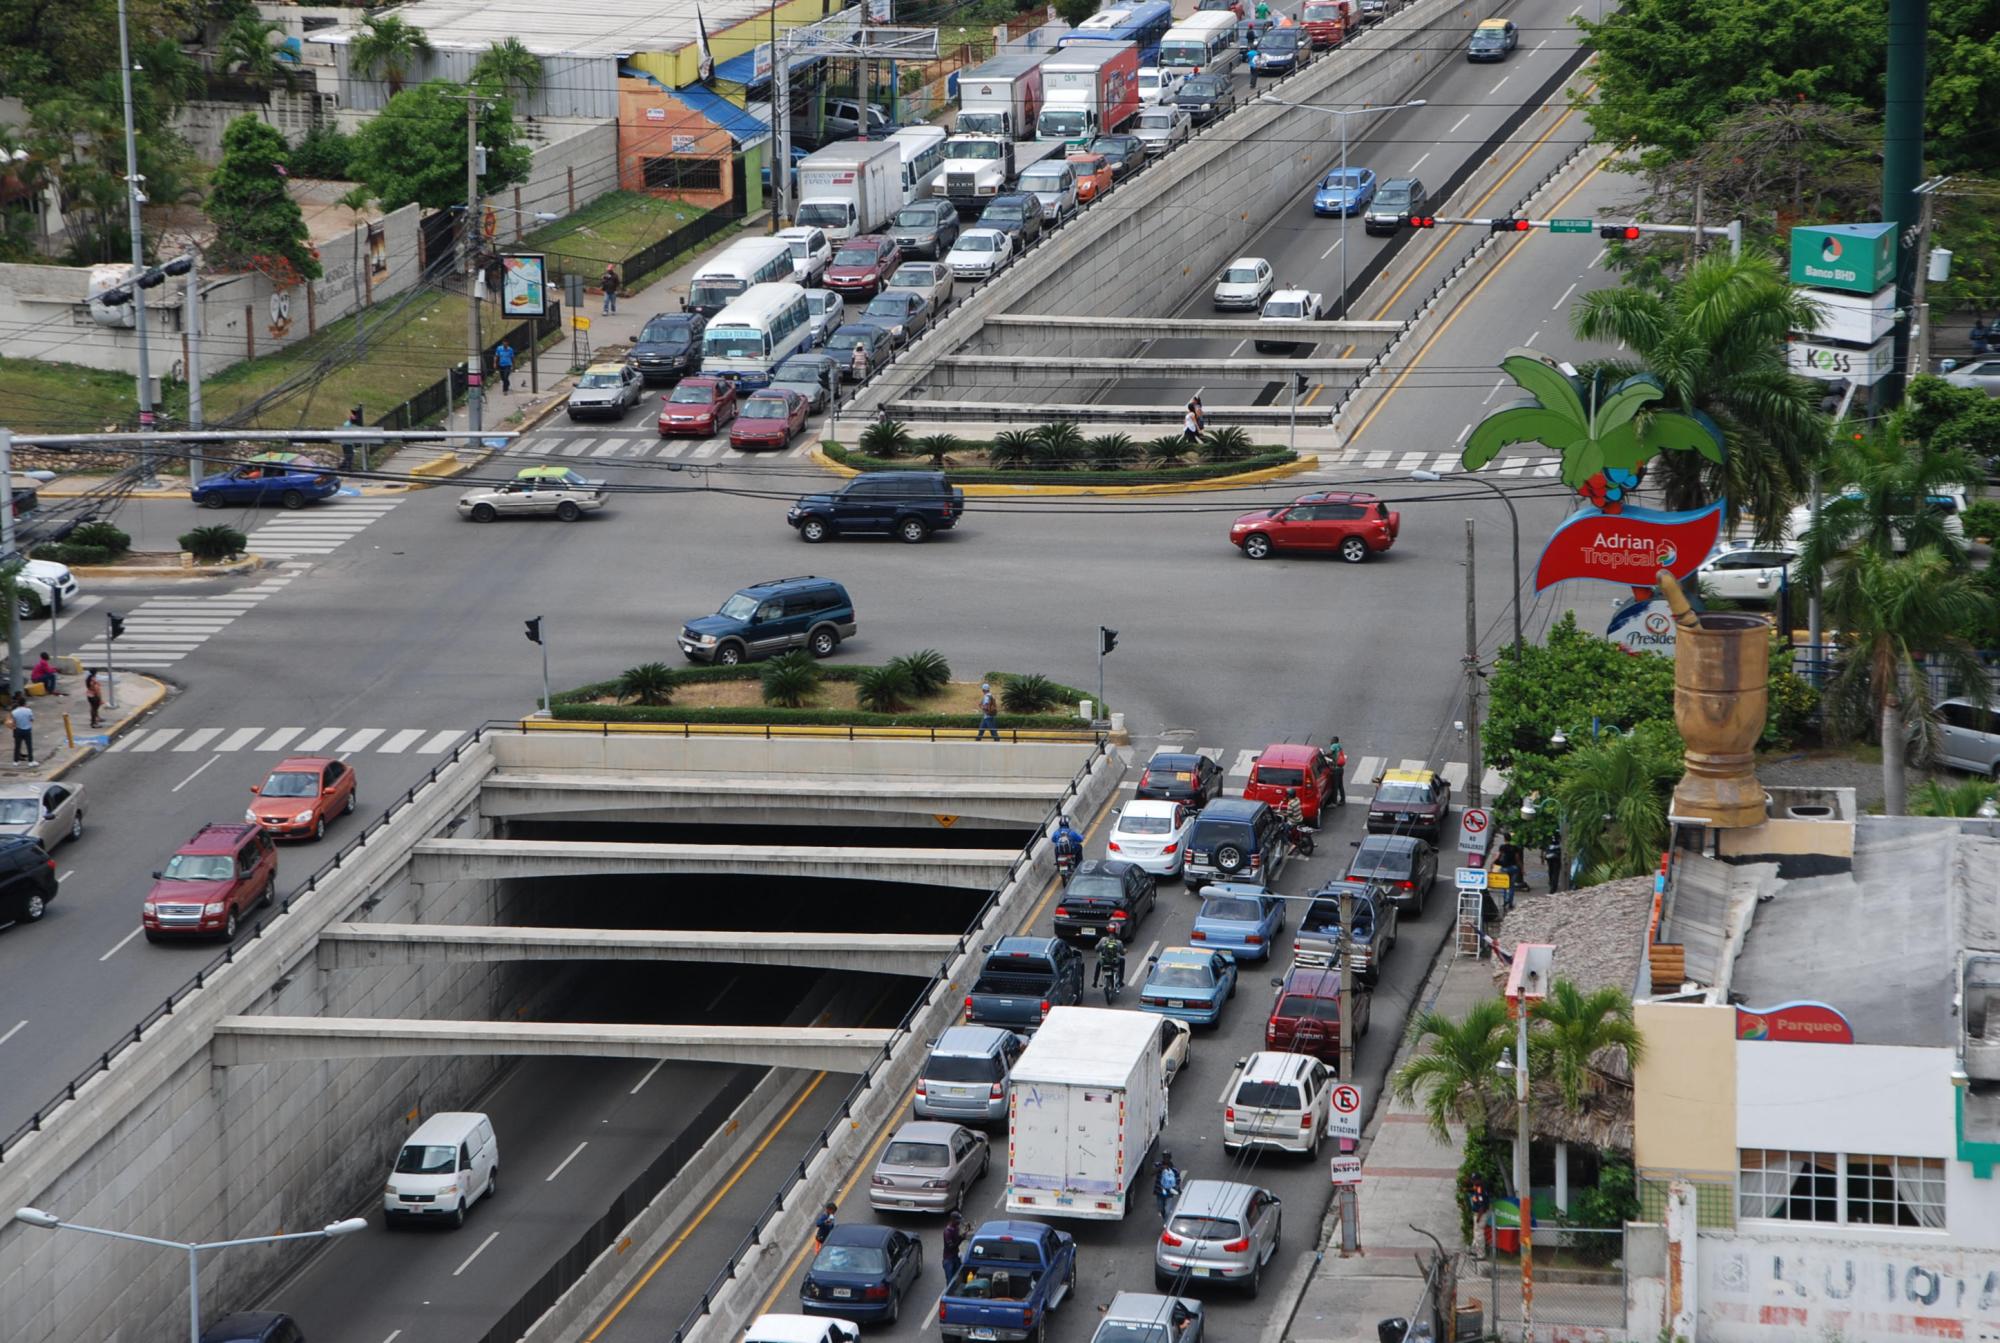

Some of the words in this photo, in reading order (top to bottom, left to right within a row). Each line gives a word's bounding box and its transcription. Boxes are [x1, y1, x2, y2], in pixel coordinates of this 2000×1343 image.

[1805, 265, 1834, 279] Banco
[1834, 269, 1856, 282] BHD
[1593, 533, 1654, 550] Adrian
[1581, 547, 1656, 569] Tropical
[1459, 871, 1485, 884] Hoy
[1777, 1019, 1843, 1034] Parqueo
